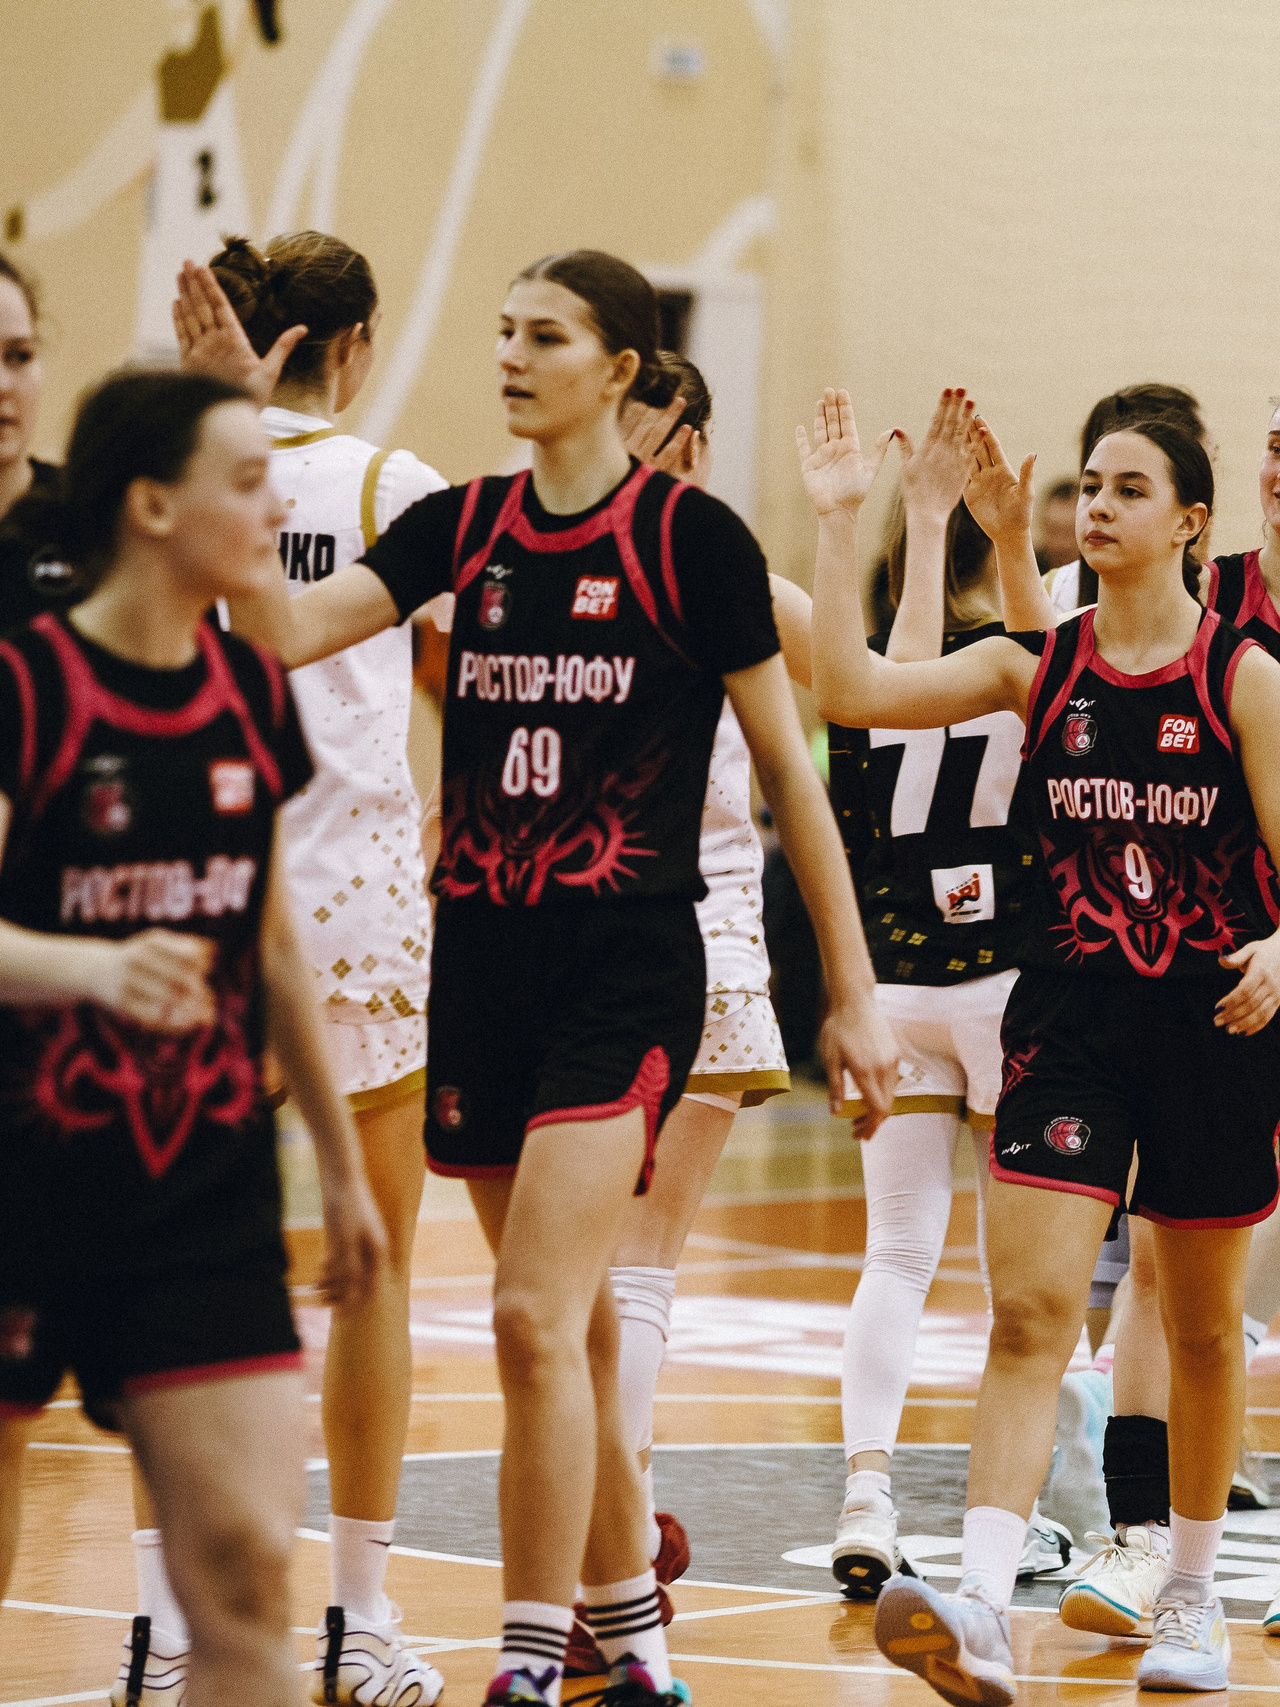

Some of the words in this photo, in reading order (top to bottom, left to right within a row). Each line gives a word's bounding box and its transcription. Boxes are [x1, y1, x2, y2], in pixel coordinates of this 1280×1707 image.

[571, 596, 614, 615] BET
[576, 579, 618, 598] FON
[1160, 733, 1196, 749] BET
[1162, 718, 1196, 734] FON
[501, 727, 562, 797] 69
[868, 710, 1027, 838] 77
[1046, 777, 1220, 826] РОСТОВ-ЮФУ
[1124, 842, 1154, 900] 9
